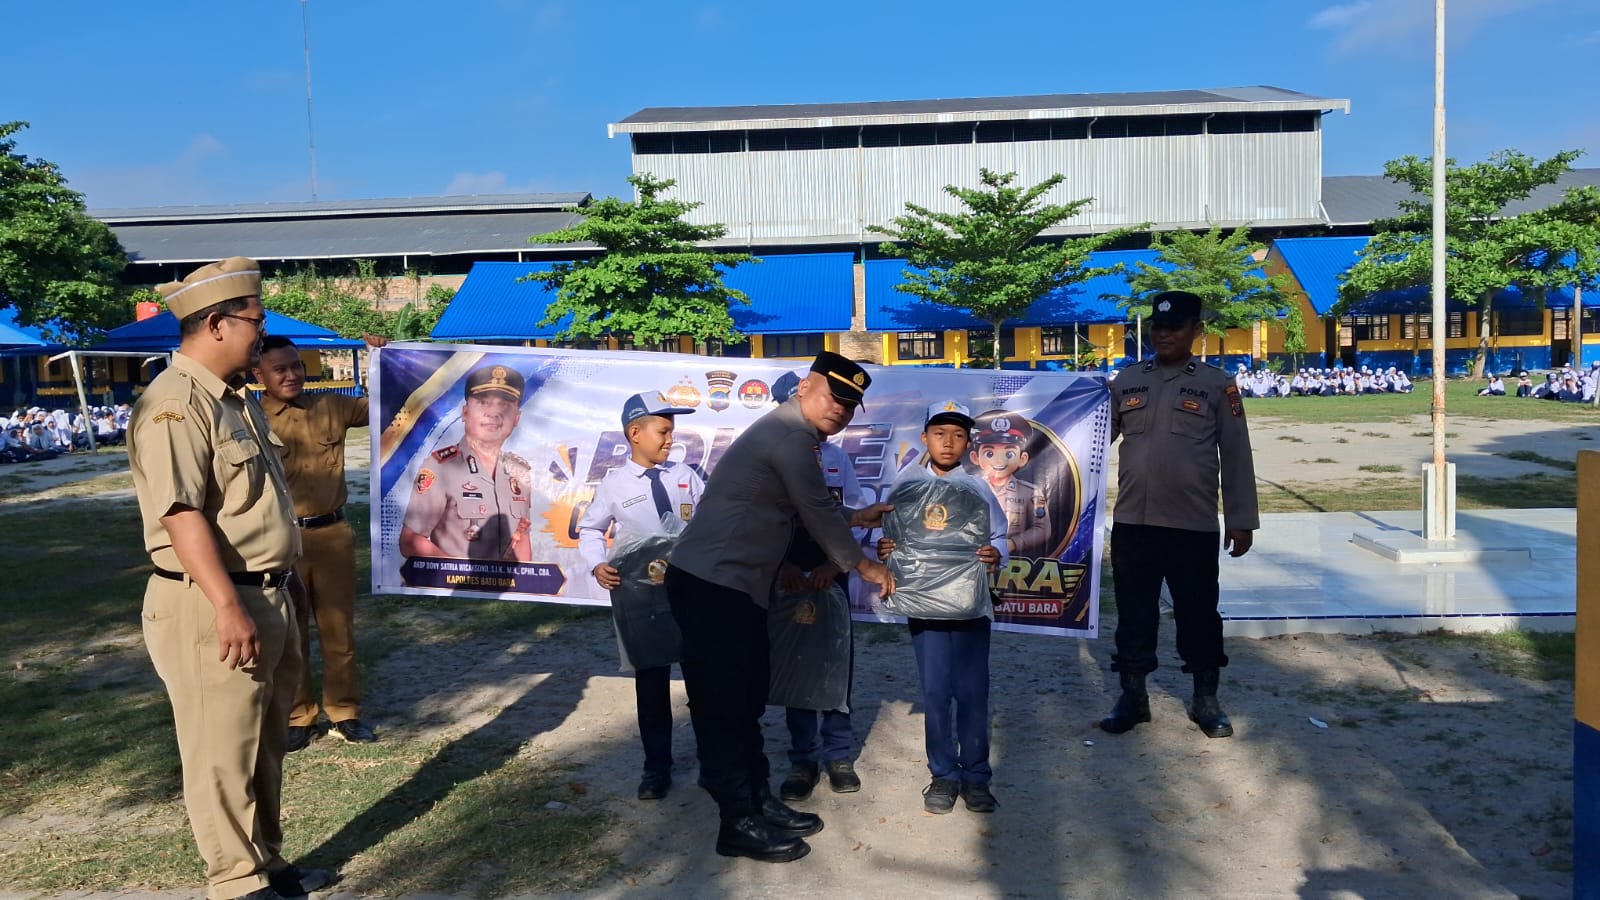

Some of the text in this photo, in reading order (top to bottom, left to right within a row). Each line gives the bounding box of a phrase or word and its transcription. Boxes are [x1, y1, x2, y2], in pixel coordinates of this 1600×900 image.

[1180, 387, 1209, 399] POLRI
[446, 575, 480, 585] KAPOLRES
[988, 558, 1065, 593] RA
[1028, 603, 1059, 614] BARA
